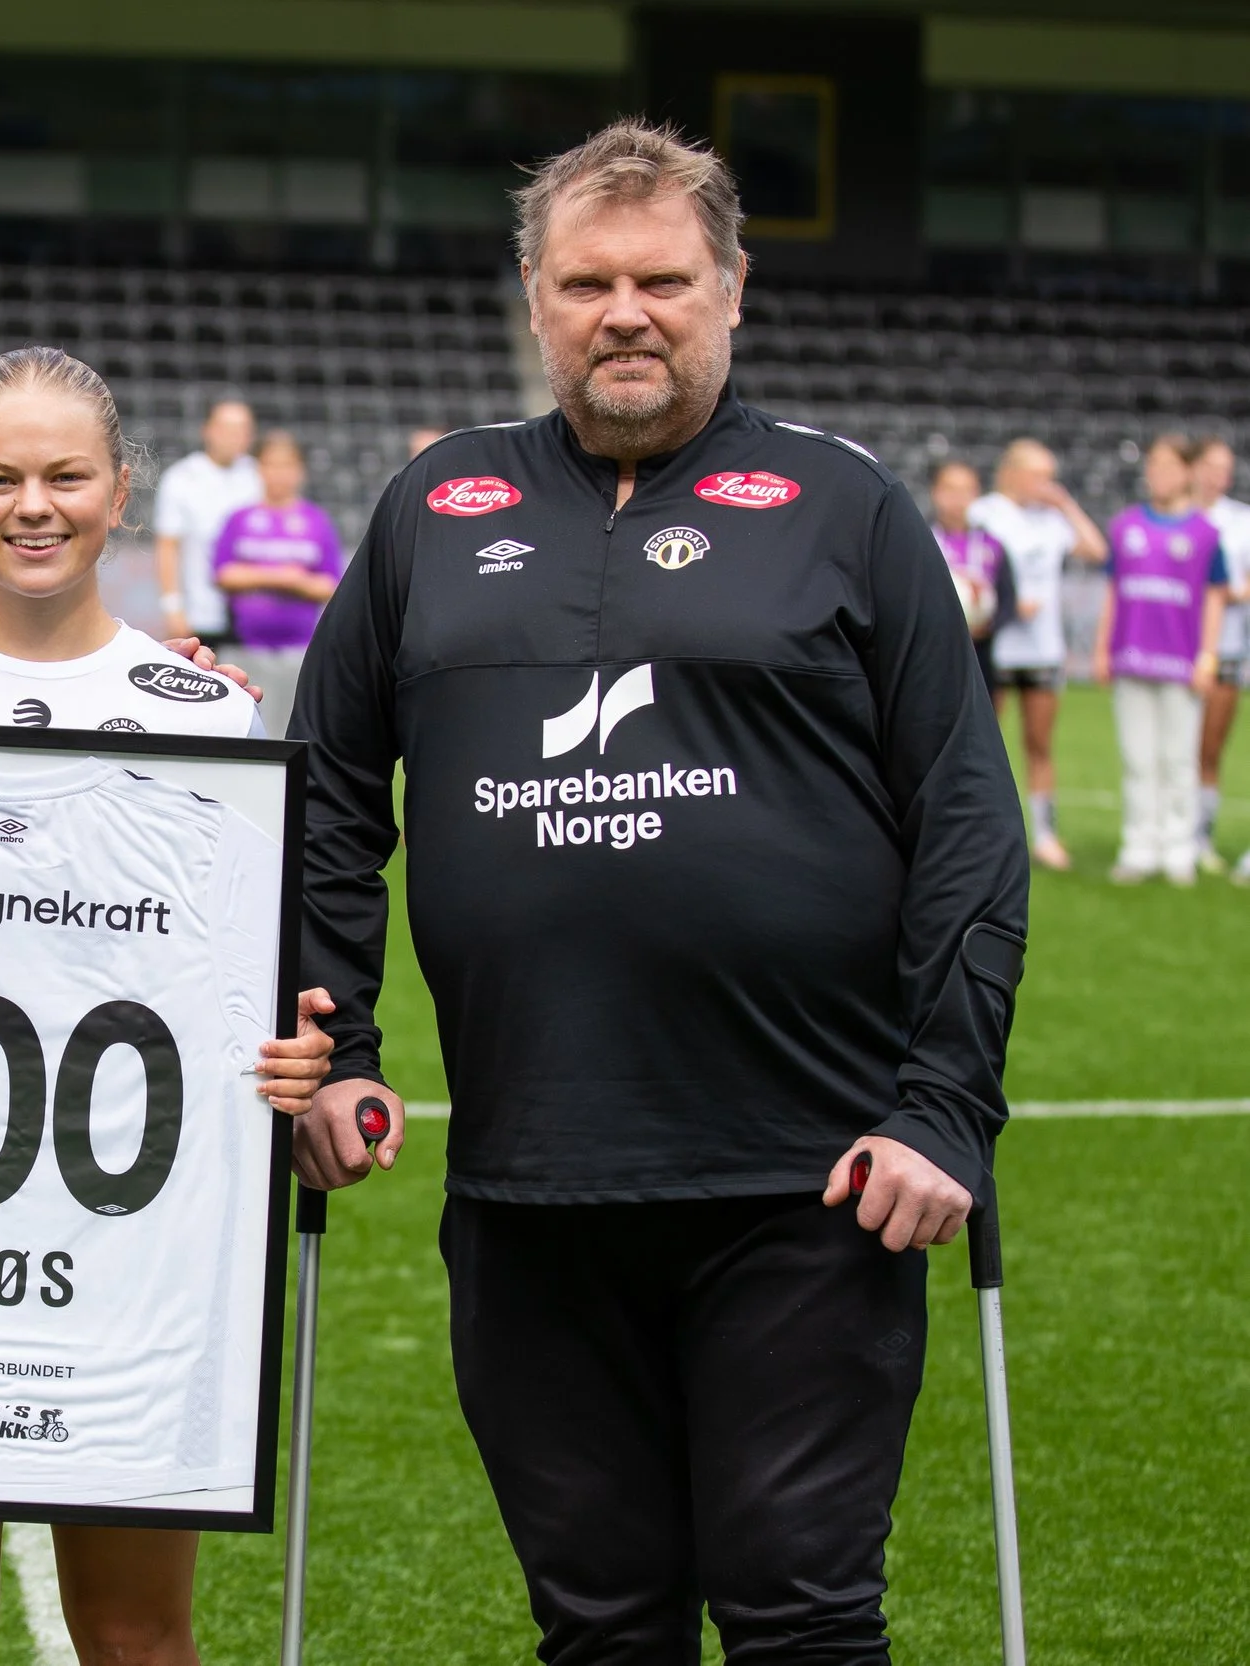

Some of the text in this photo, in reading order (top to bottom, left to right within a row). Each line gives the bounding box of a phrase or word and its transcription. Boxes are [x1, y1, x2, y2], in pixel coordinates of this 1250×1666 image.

[433, 481, 510, 513] Lerum
[700, 475, 788, 505] Lerum
[650, 530, 705, 550] SOGNDAL
[478, 561, 524, 575] umbro
[134, 665, 219, 700] Lerum
[98, 719, 144, 733] OGND
[474, 762, 737, 818] Sparebanken
[536, 809, 663, 850] Norge
